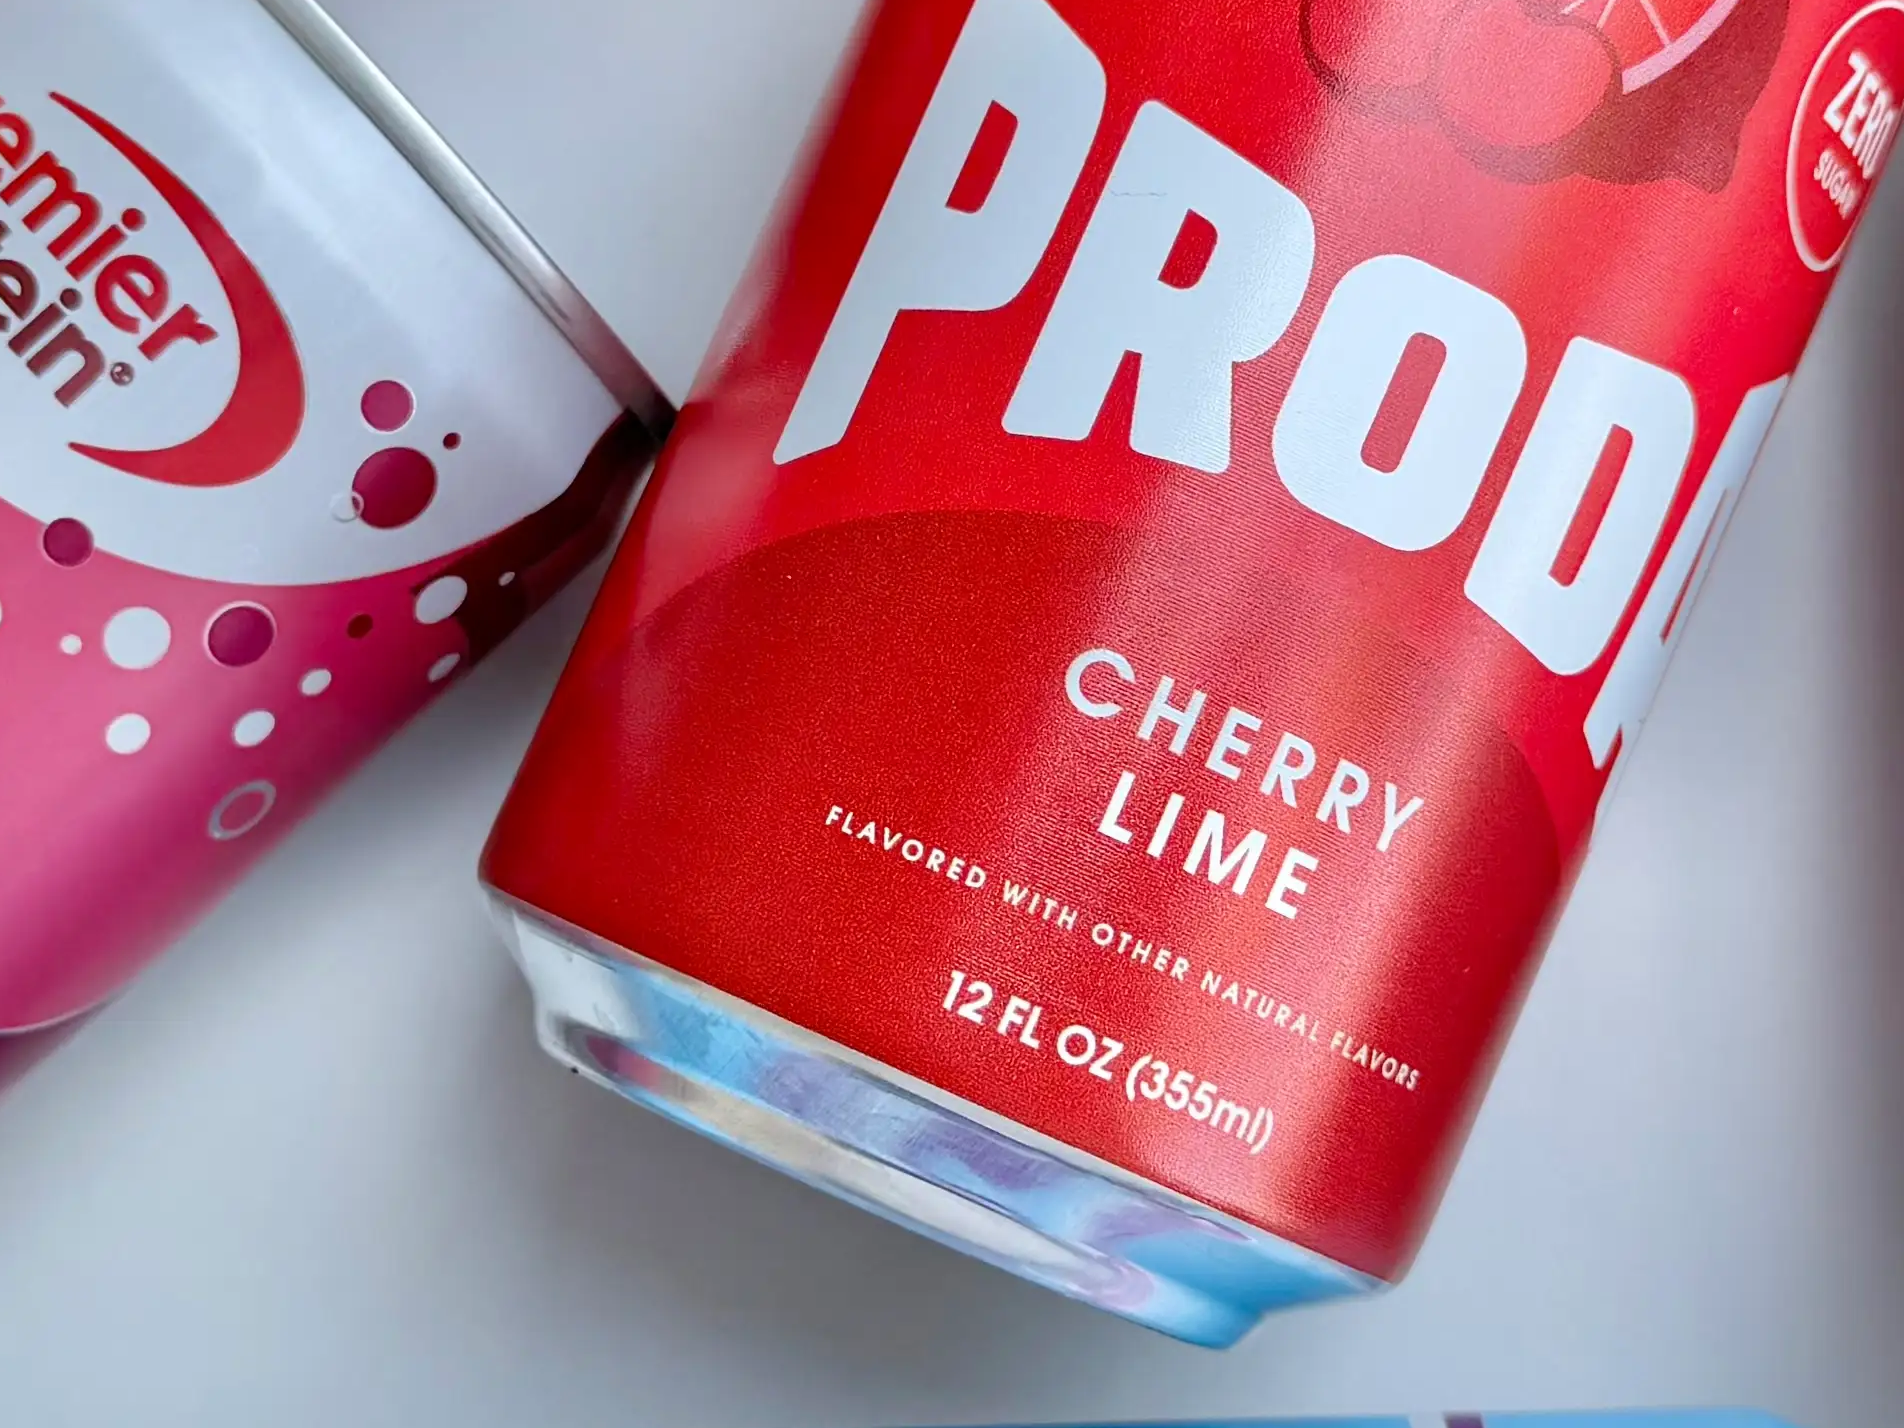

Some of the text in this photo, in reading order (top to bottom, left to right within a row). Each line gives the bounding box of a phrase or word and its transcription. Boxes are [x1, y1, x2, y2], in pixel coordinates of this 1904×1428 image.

[1824, 50, 1901, 180] ZERO
[1065, 648, 1424, 853] CHERRY
[1097, 771, 1319, 920] LIME
[825, 805, 1421, 1092] FLAVORED WITH OTHER NATURAL FLAVORS
[941, 971, 1275, 1155] 12 FL OZ (355ml)
